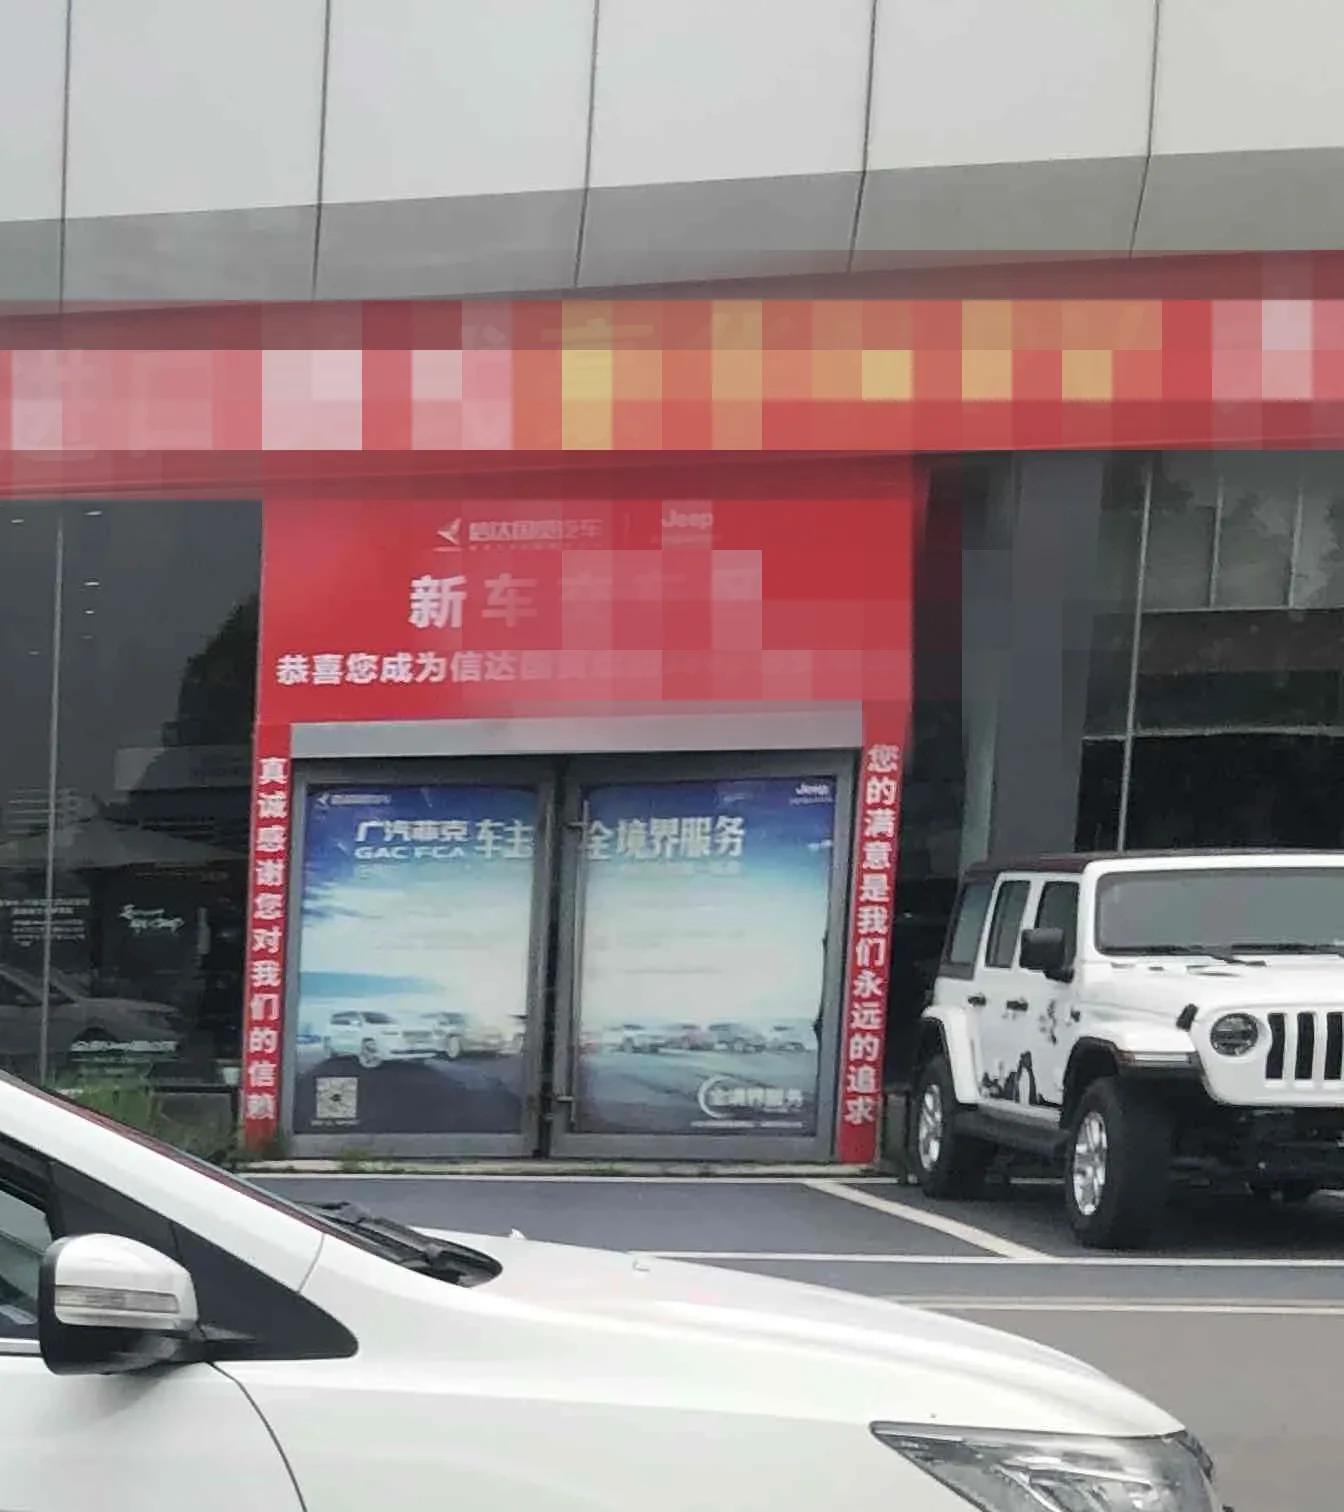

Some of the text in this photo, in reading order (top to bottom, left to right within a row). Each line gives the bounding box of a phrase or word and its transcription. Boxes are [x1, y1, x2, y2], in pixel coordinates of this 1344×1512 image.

[245, 757, 288, 1120] 真诚感谢您对我们的信赖
[354, 846, 465, 860] GAC FCA
[587, 815, 746, 860] 全境界服务
[843, 744, 900, 1126] 您的满意是我们永远的追求
